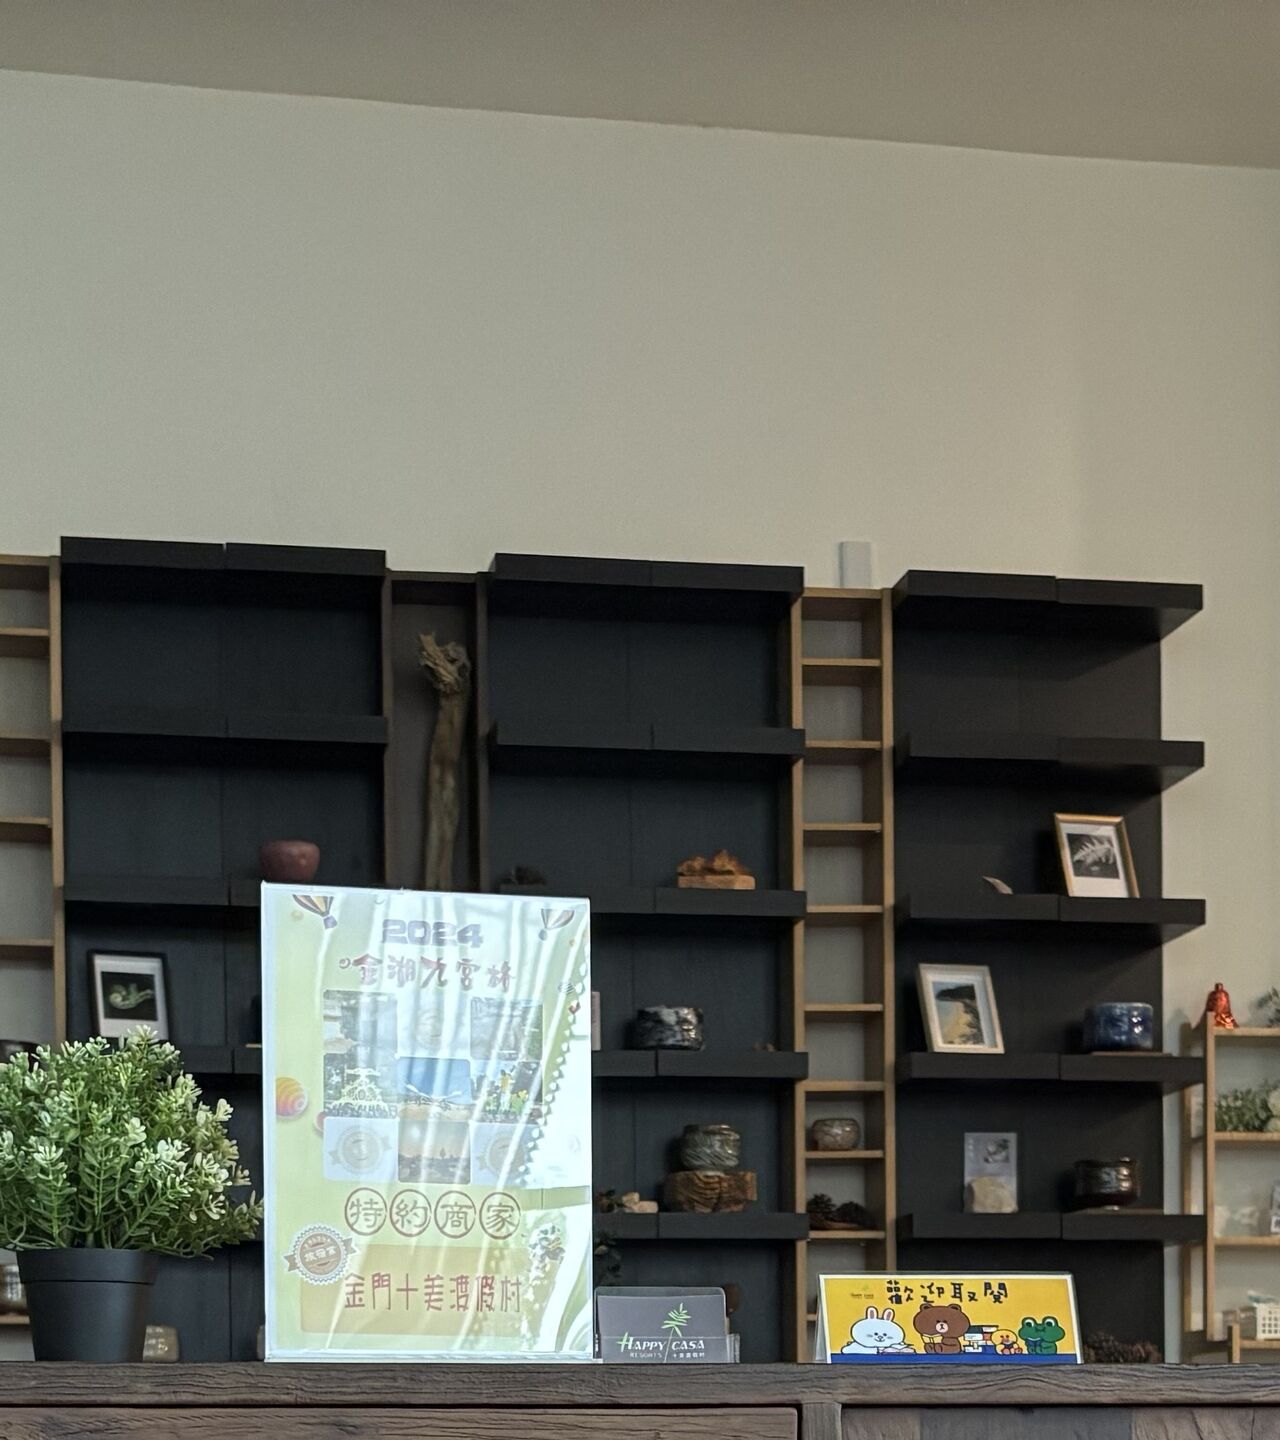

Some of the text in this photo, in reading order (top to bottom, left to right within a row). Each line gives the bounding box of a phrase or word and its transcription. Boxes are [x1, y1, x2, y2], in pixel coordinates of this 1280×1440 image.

[382, 919, 484, 948] 2024
[348, 1194, 517, 1235] 特約商家
[345, 1272, 522, 1312] 金門十美渡假村
[886, 1280, 1008, 1304] 歡迎取閱
[672, 1340, 705, 1350] CASA
